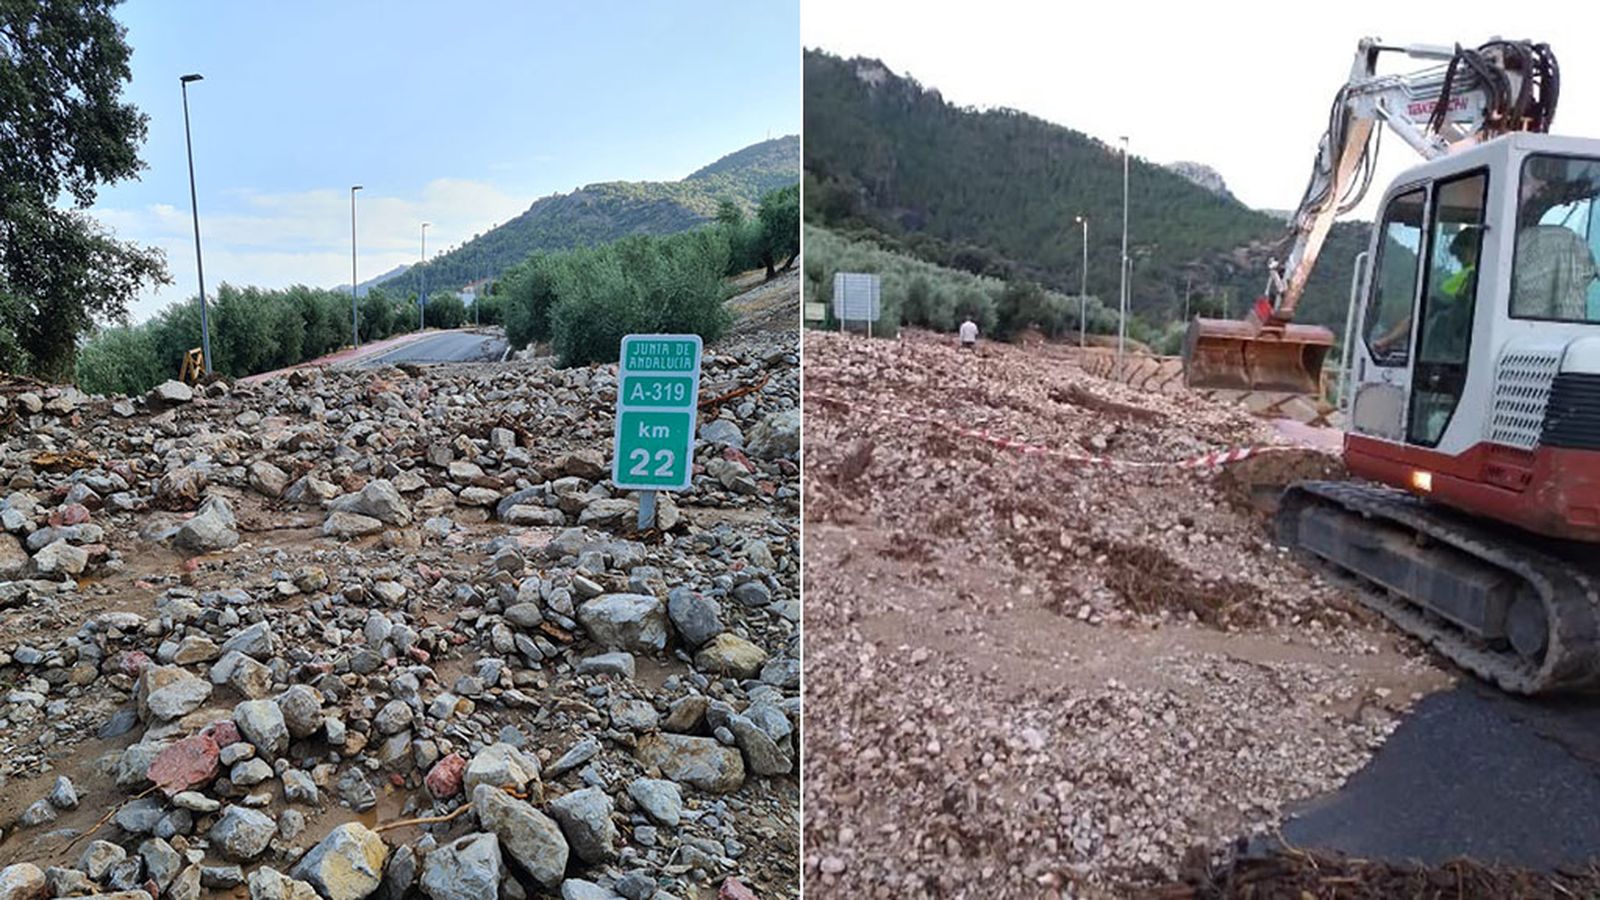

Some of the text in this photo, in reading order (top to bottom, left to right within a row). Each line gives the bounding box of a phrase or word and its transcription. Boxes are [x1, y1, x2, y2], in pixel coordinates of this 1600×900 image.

[633, 343, 690, 356] JUNTA DE
[630, 382, 685, 401] A-319
[638, 421, 670, 438] km
[629, 448, 675, 477] 22
